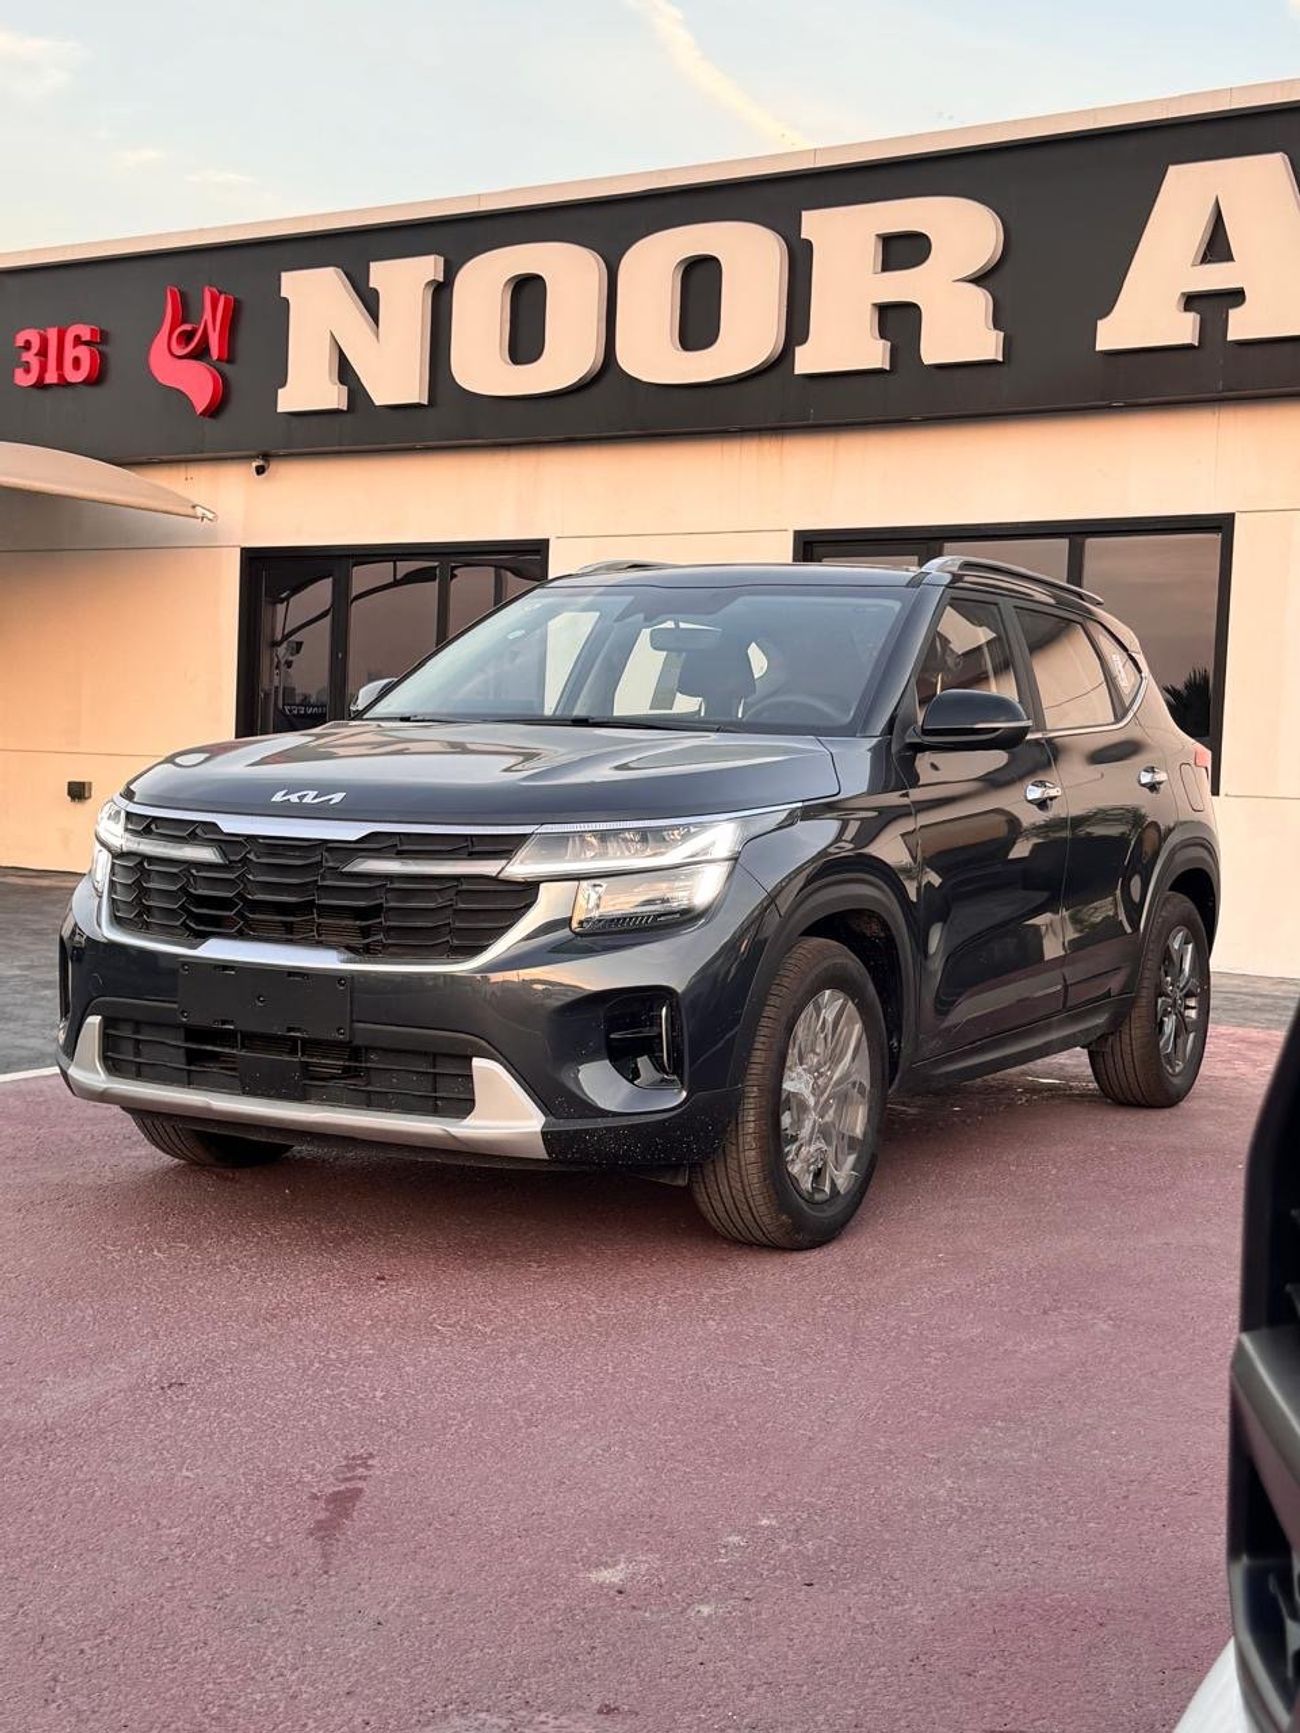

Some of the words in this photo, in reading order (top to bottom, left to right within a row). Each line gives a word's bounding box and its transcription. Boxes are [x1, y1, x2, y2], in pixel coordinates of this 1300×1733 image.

[277, 195, 1005, 413] NOOR
[1096, 152, 1300, 352] A
[14, 323, 101, 388] 316
[271, 789, 346, 804] KIA
